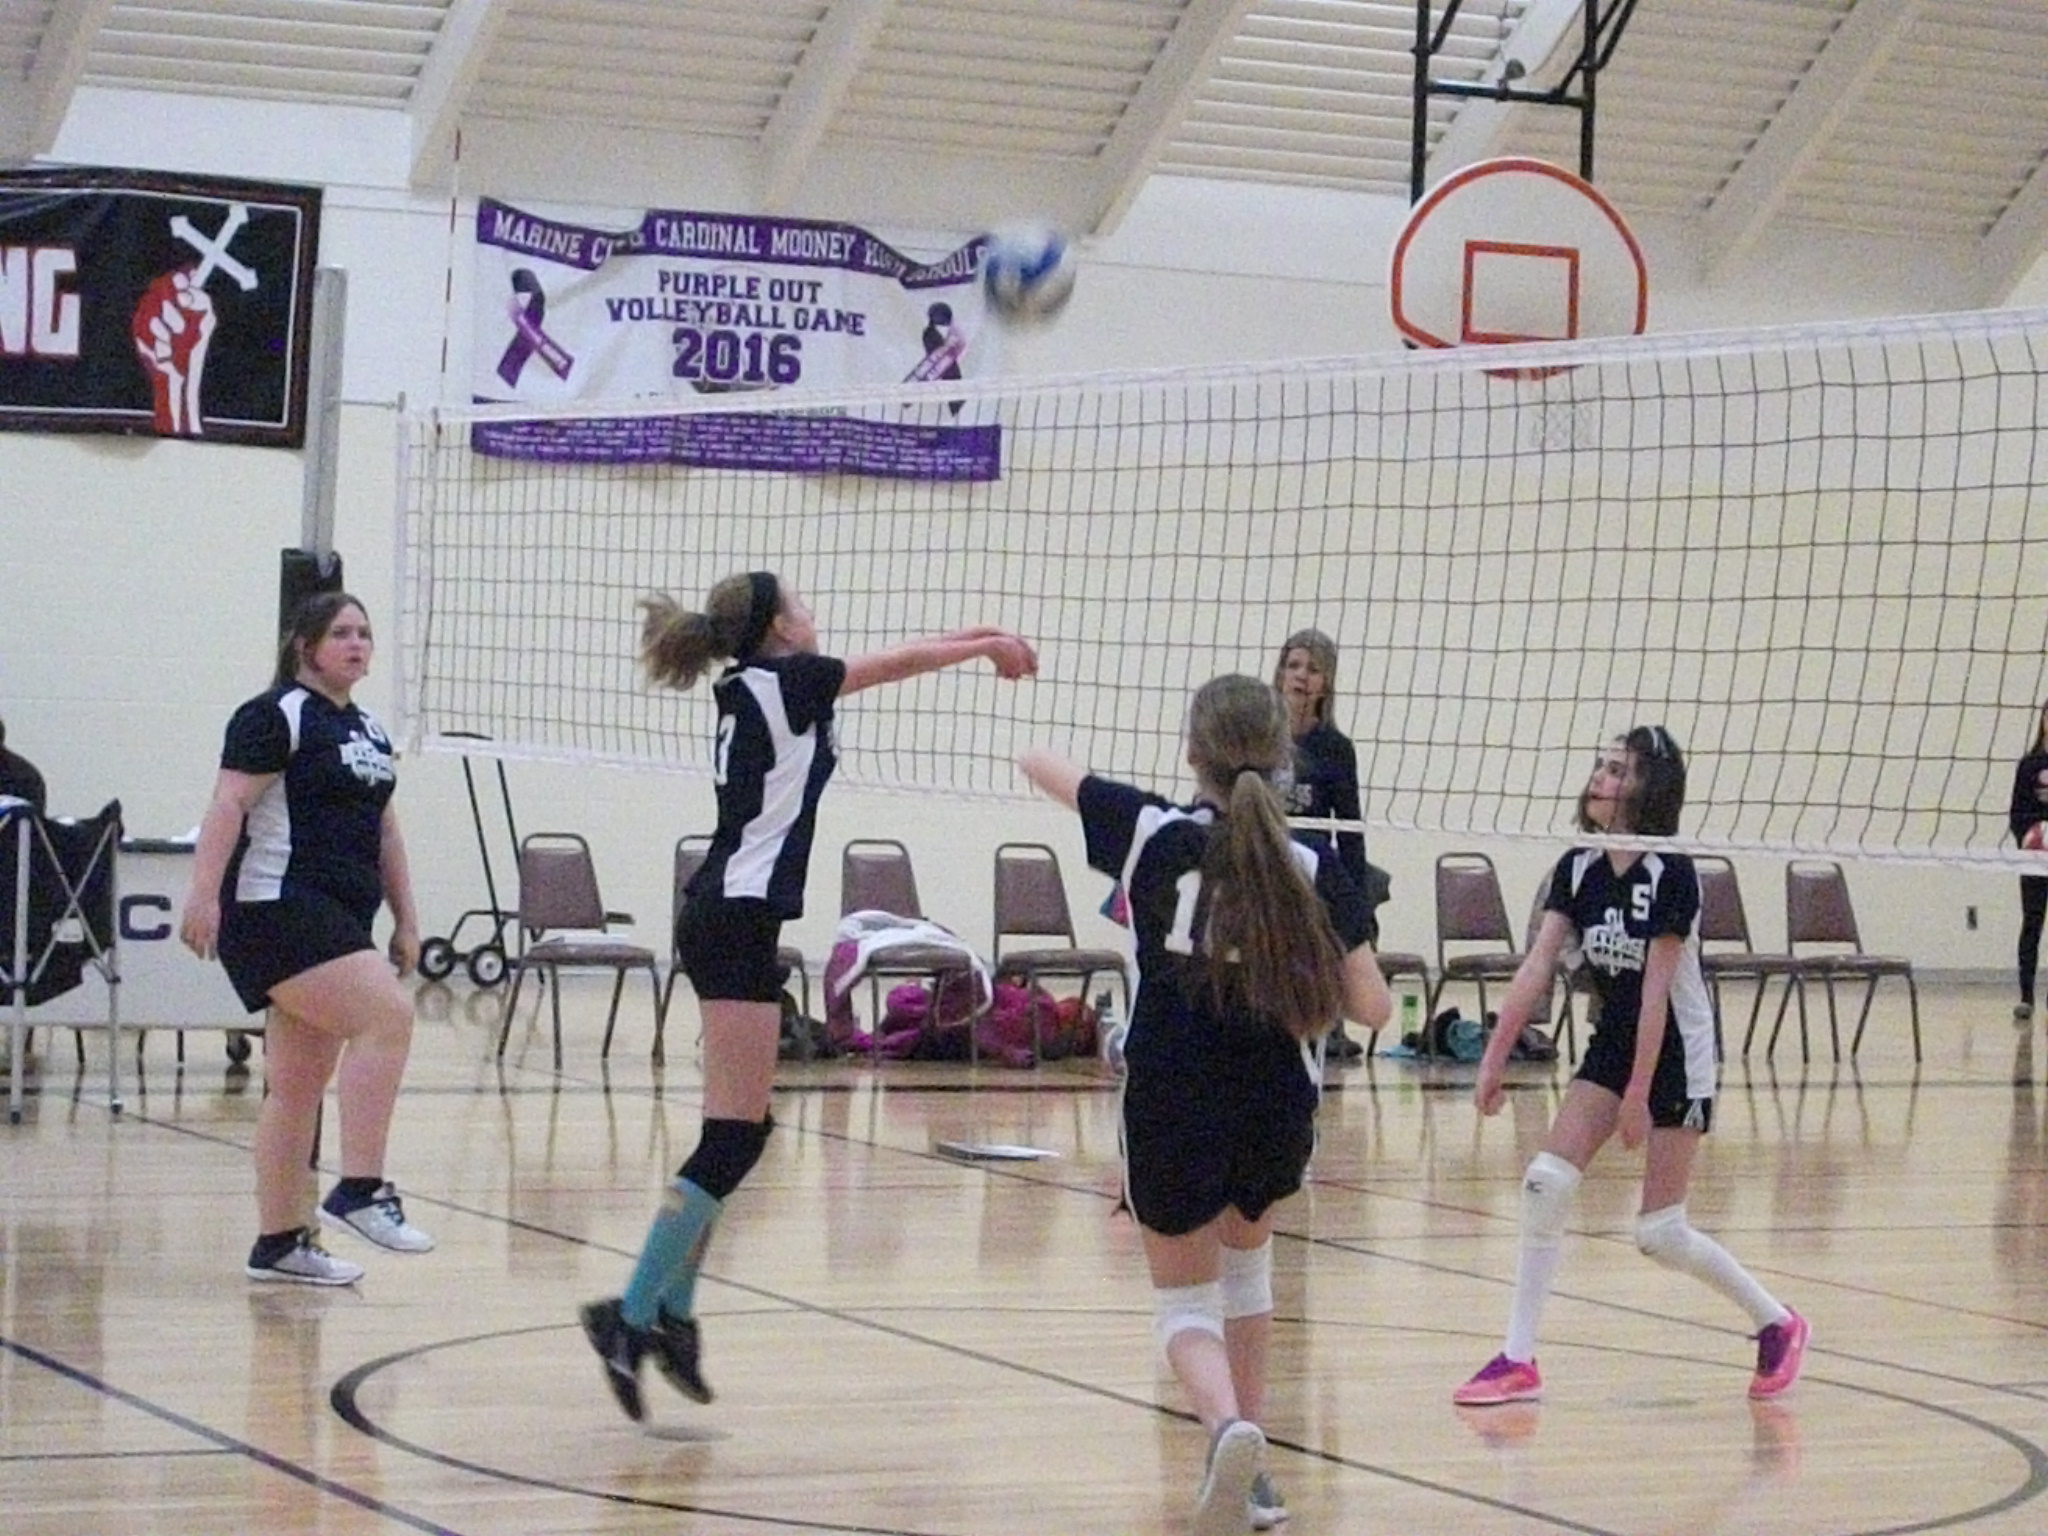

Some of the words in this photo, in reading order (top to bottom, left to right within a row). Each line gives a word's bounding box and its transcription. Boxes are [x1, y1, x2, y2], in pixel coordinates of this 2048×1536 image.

[493, 210, 585, 259] MARINE
[655, 218, 760, 254] CARDINAL
[771, 227, 857, 260] MOONEY
[658, 270, 761, 301] PURPLE
[768, 277, 823, 304] OUT
[605, 298, 786, 329] VOLLEYBALL
[793, 308, 866, 336] GAME
[672, 326, 802, 385] 2016
[119, 894, 171, 941] C
[1631, 883, 1651, 921] 5
